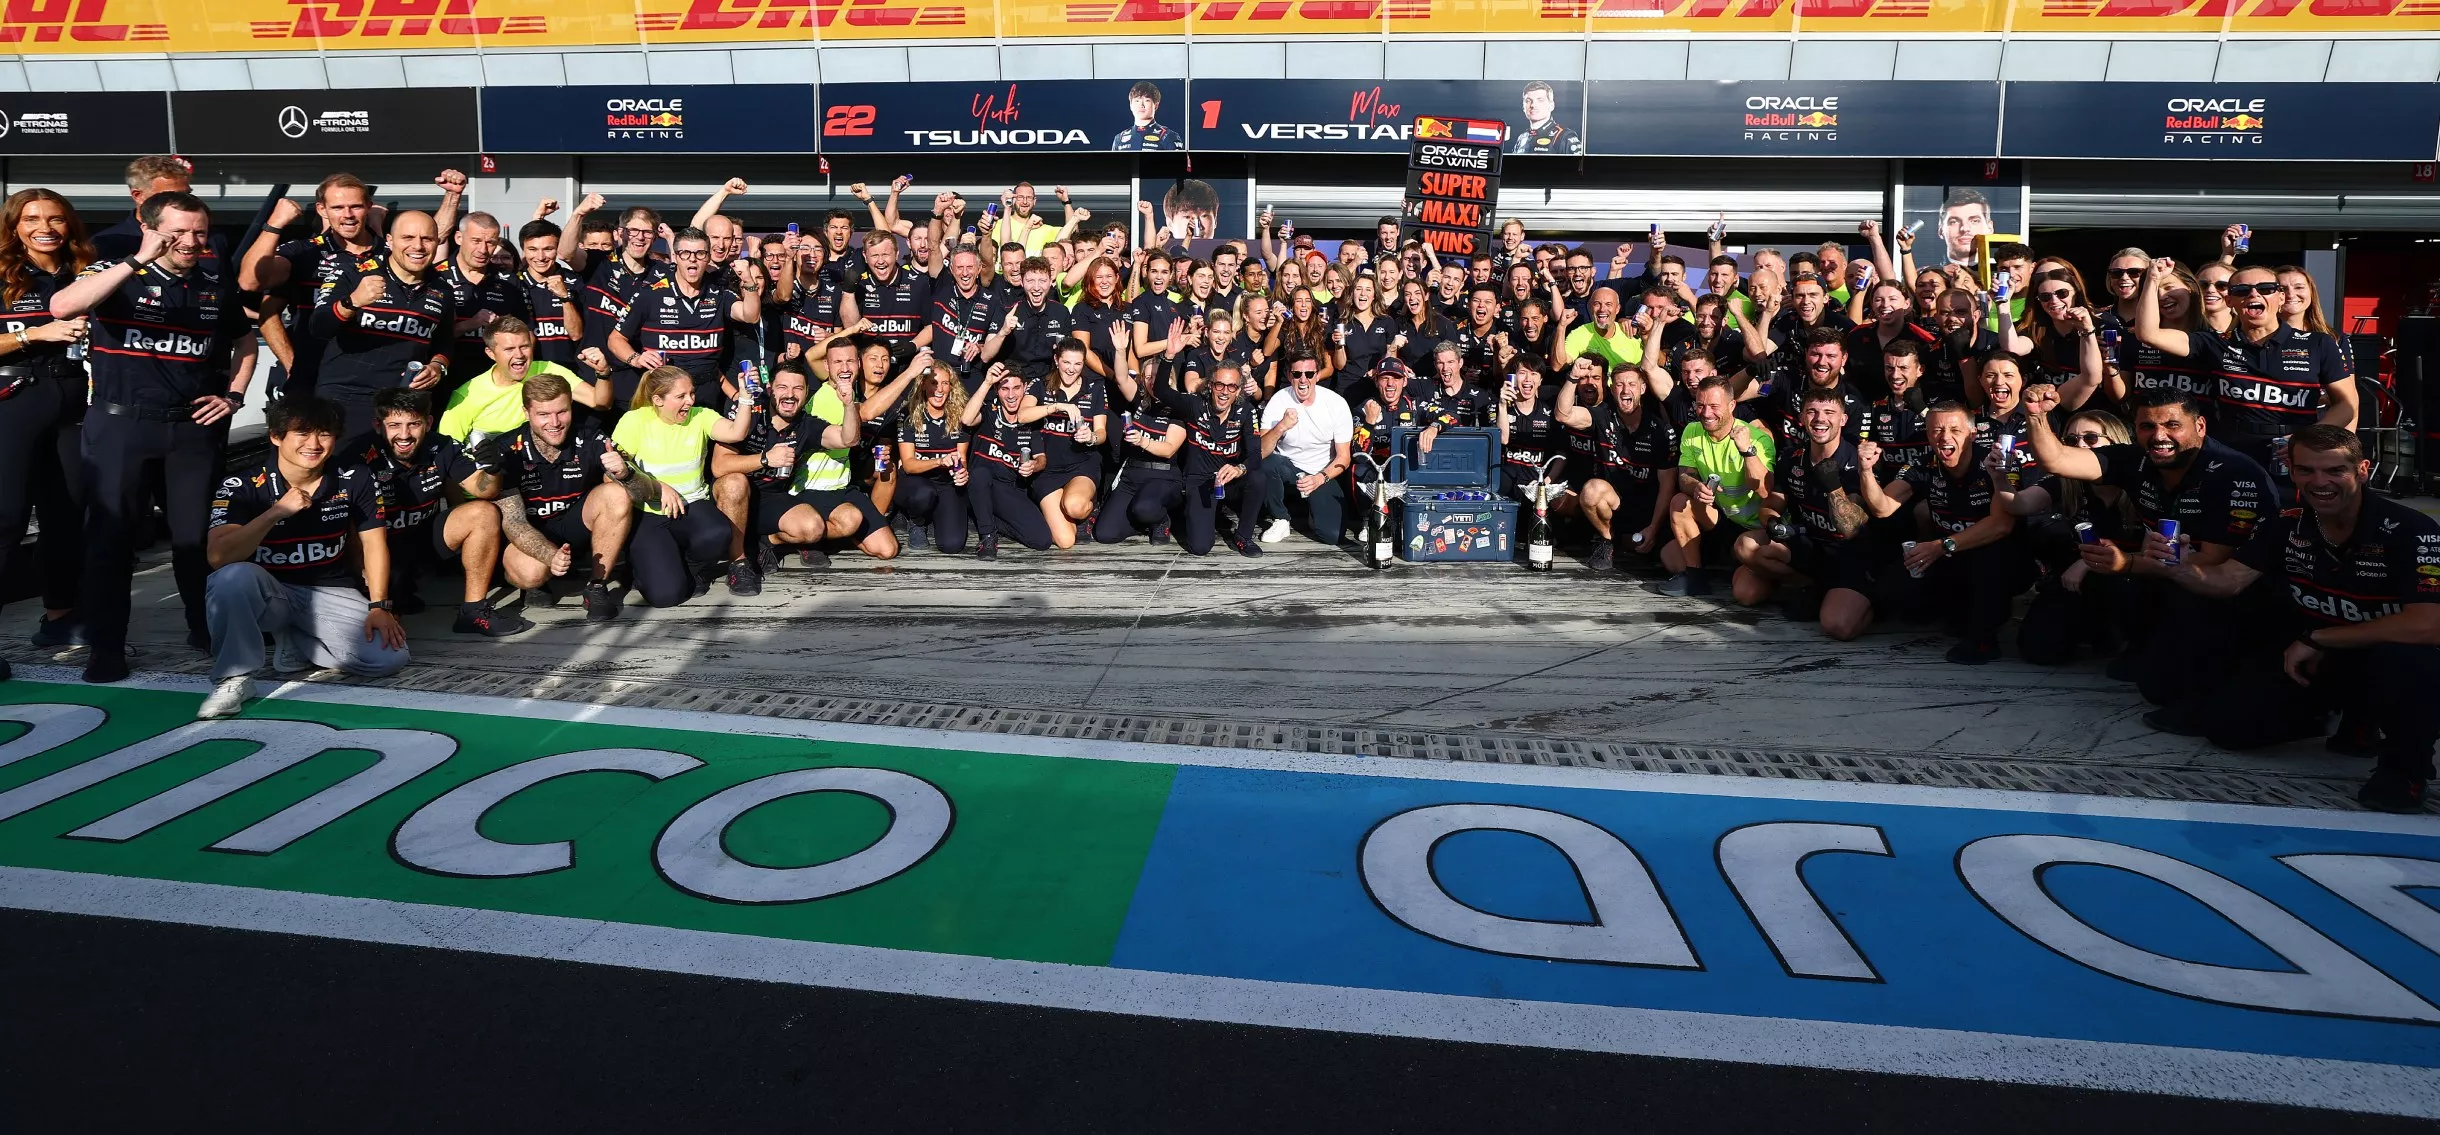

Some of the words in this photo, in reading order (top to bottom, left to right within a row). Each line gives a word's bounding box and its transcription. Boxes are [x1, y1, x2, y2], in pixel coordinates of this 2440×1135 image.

[288, 0, 504, 38] DHL
[606, 98, 683, 112] ORACLE
[971, 83, 1021, 134] Yuki
[1350, 86, 1401, 130] Max
[1745, 96, 1839, 110] ORACLE
[2167, 98, 2266, 113] ORACLE
[607, 114, 628, 127] Red
[628, 114, 648, 127] Bull
[823, 104, 877, 136] 22
[1200, 100, 1222, 129] 1
[1745, 113, 1771, 126] Red
[1771, 113, 1795, 126] Bull
[13, 119, 68, 127] PETRONAS
[312, 118, 369, 127] PETRONAS
[2165, 115, 2192, 130] Red
[2192, 115, 2219, 130] Bull
[607, 131, 684, 139] RACING
[904, 129, 1091, 146] TSUNODA
[1744, 132, 1838, 141] RACING
[2164, 135, 2263, 144] RACING
[1421, 144, 1489, 160] ORACLE
[820, 157, 830, 170] 22
[1419, 155, 1445, 167] 50
[1447, 156, 1488, 170] WINS
[1985, 162, 1996, 177] 19
[2413, 165, 2433, 179] 18
[1421, 171, 1487, 199] SUPER
[1421, 203, 1480, 227] MAX!
[1423, 229, 1475, 255] WINS
[1491, 272, 1504, 282] ed
[360, 313, 404, 333] Red
[869, 320, 887, 332] ed
[888, 319, 911, 332] Bull
[123, 329, 175, 352] Red
[658, 334, 689, 350] Red
[690, 333, 718, 349] Bull
[2134, 371, 2174, 389] Red
[2219, 378, 2261, 401] Red
[2263, 384, 2310, 408] Bull
[1570, 435, 1591, 451] Red
[1425, 453, 1473, 470] YETI
[1505, 448, 1522, 461] ed
[1608, 449, 1625, 465] Re
[2232, 481, 2256, 489] VISA
[526, 502, 551, 517] ed
[2230, 500, 2258, 509] ROKT
[385, 510, 406, 529] ed
[254, 543, 305, 564] Red
[307, 533, 348, 561] Bull
[2417, 556, 2440, 564] ROK
[2289, 583, 2337, 617] Red
[1356, 801, 2440, 1026] ara
